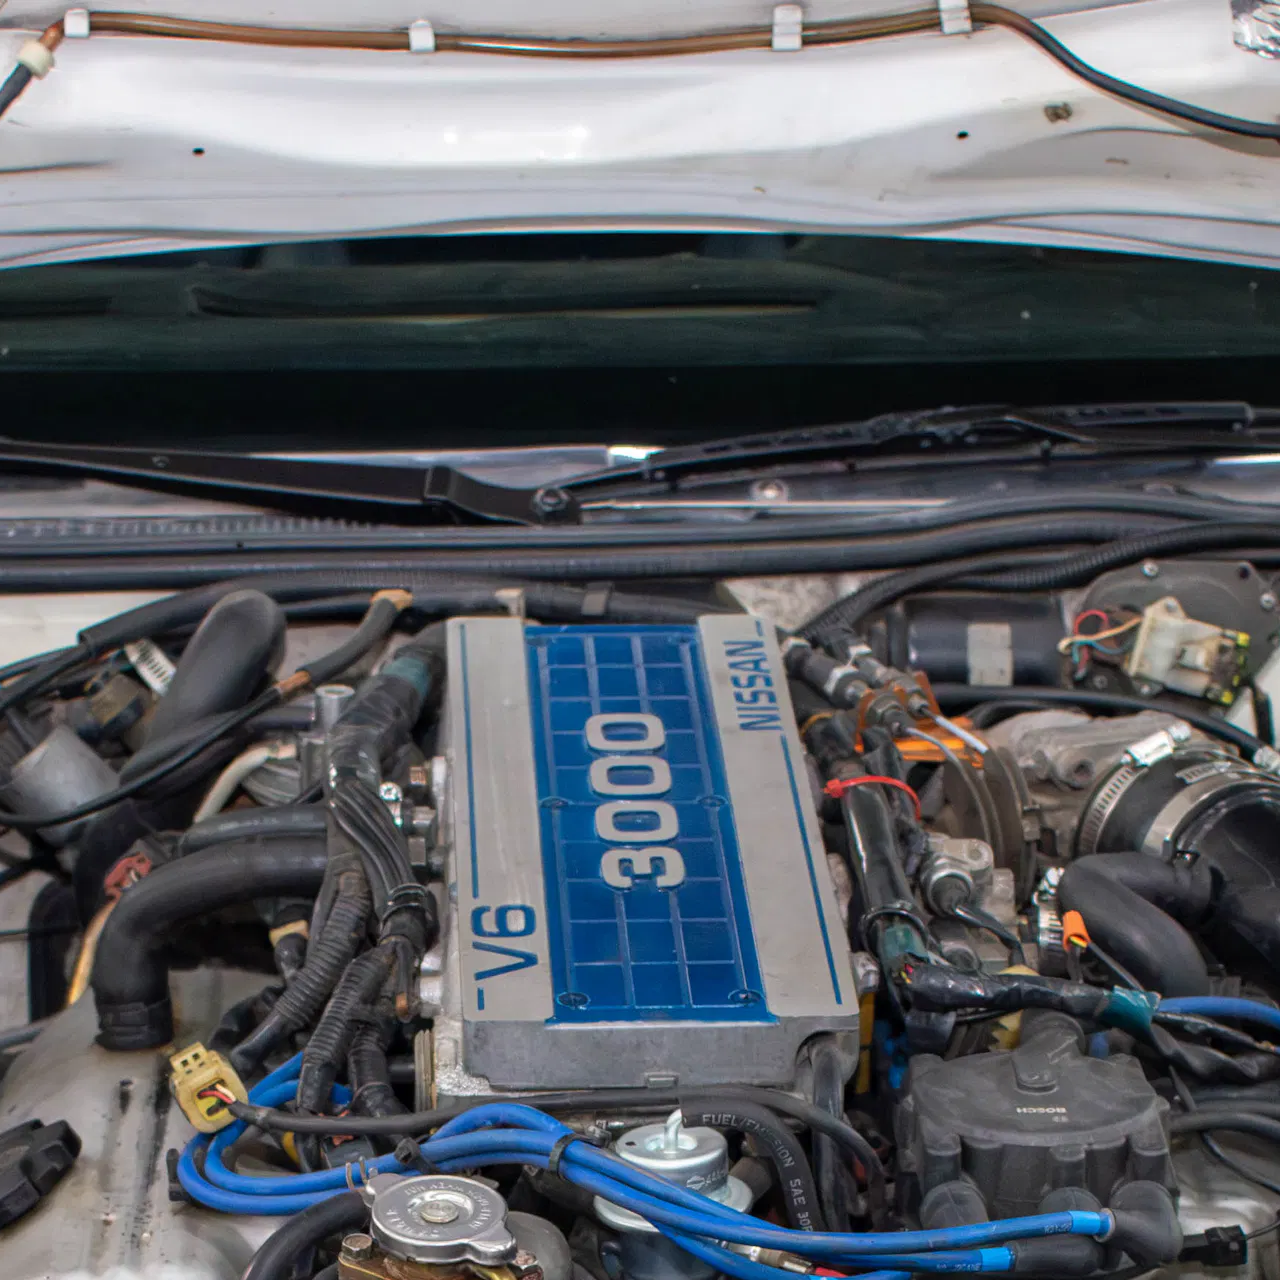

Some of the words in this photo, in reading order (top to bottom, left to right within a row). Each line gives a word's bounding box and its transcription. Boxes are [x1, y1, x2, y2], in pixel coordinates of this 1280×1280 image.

[722, 639, 784, 732] NISSAN
[584, 711, 686, 892] 3000
[470, 903, 538, 982] V6
[789, 1177, 807, 1207] SAE
